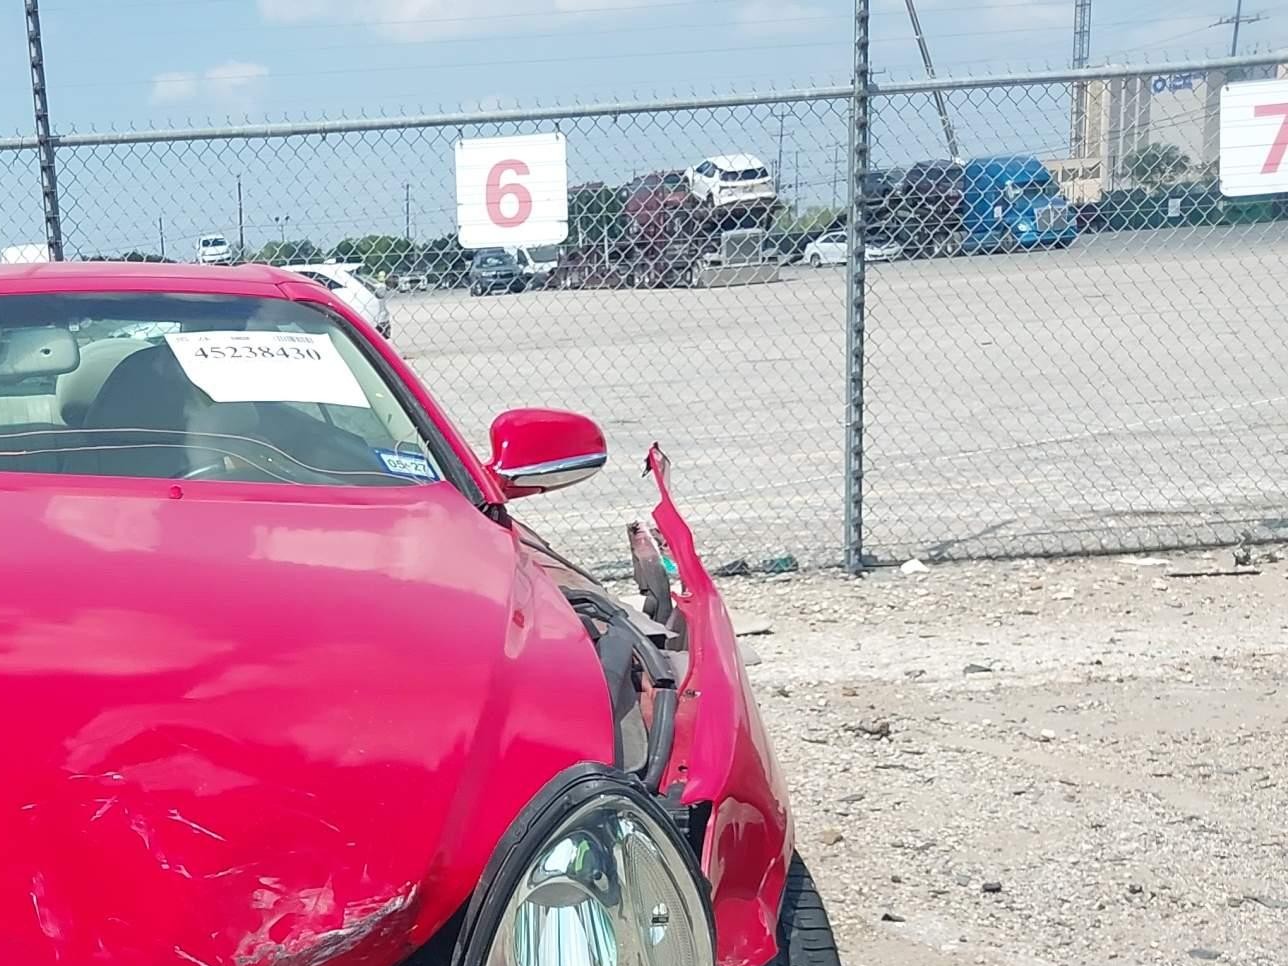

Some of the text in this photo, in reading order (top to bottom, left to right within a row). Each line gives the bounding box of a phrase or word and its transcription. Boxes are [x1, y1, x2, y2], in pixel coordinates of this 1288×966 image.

[1254, 103, 1288, 175] 7
[486, 159, 533, 228] 6
[194, 345, 322, 361] 45238430
